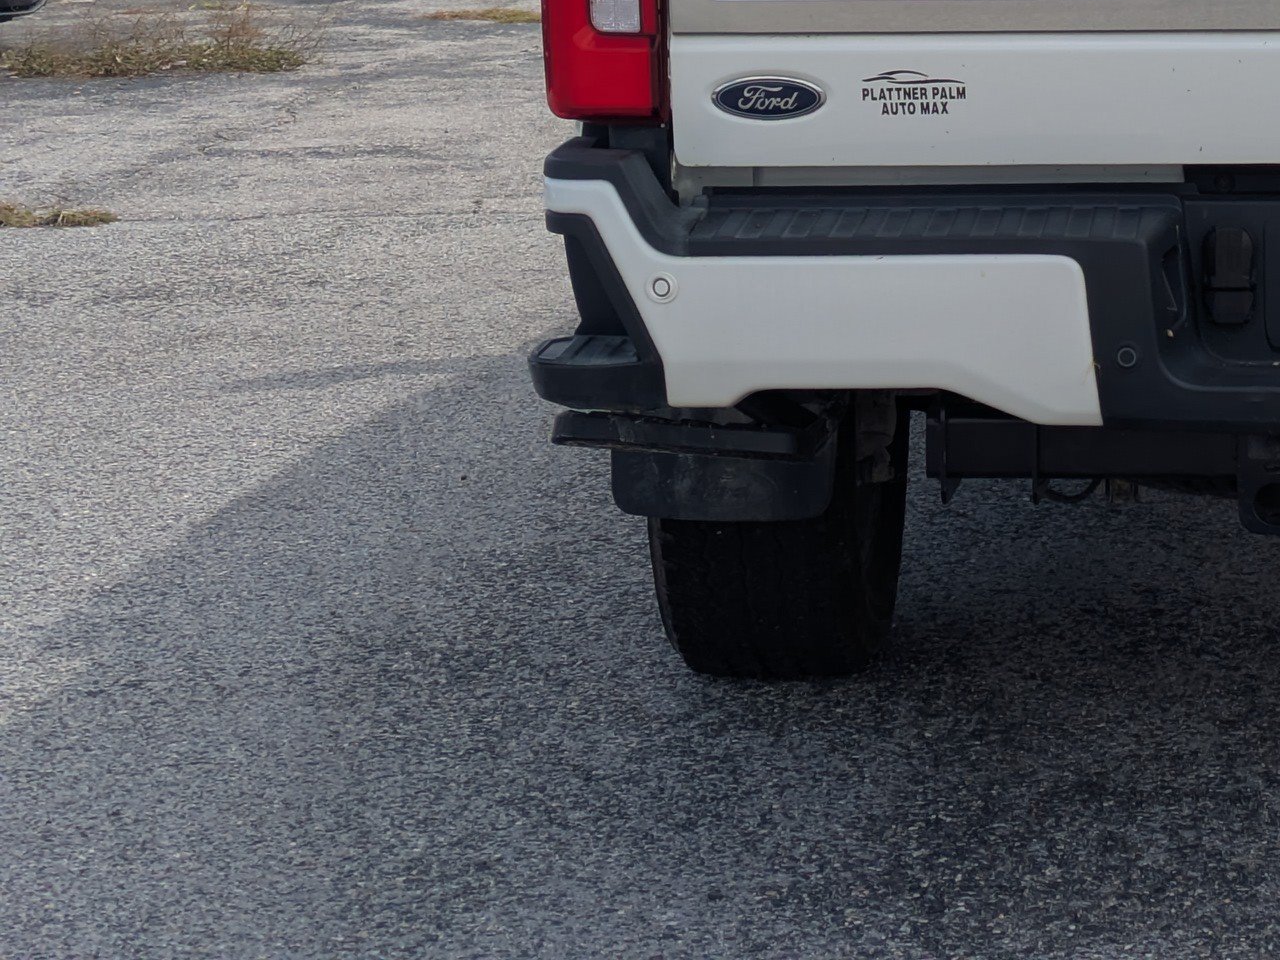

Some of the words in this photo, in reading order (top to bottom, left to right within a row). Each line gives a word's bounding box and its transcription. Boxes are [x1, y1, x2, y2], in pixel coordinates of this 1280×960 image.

[738, 85, 798, 110] Ford
[861, 87, 928, 101] PLATTNER
[931, 86, 967, 100] PALM
[881, 102, 917, 116] AUTO
[920, 101, 950, 115] MAX
